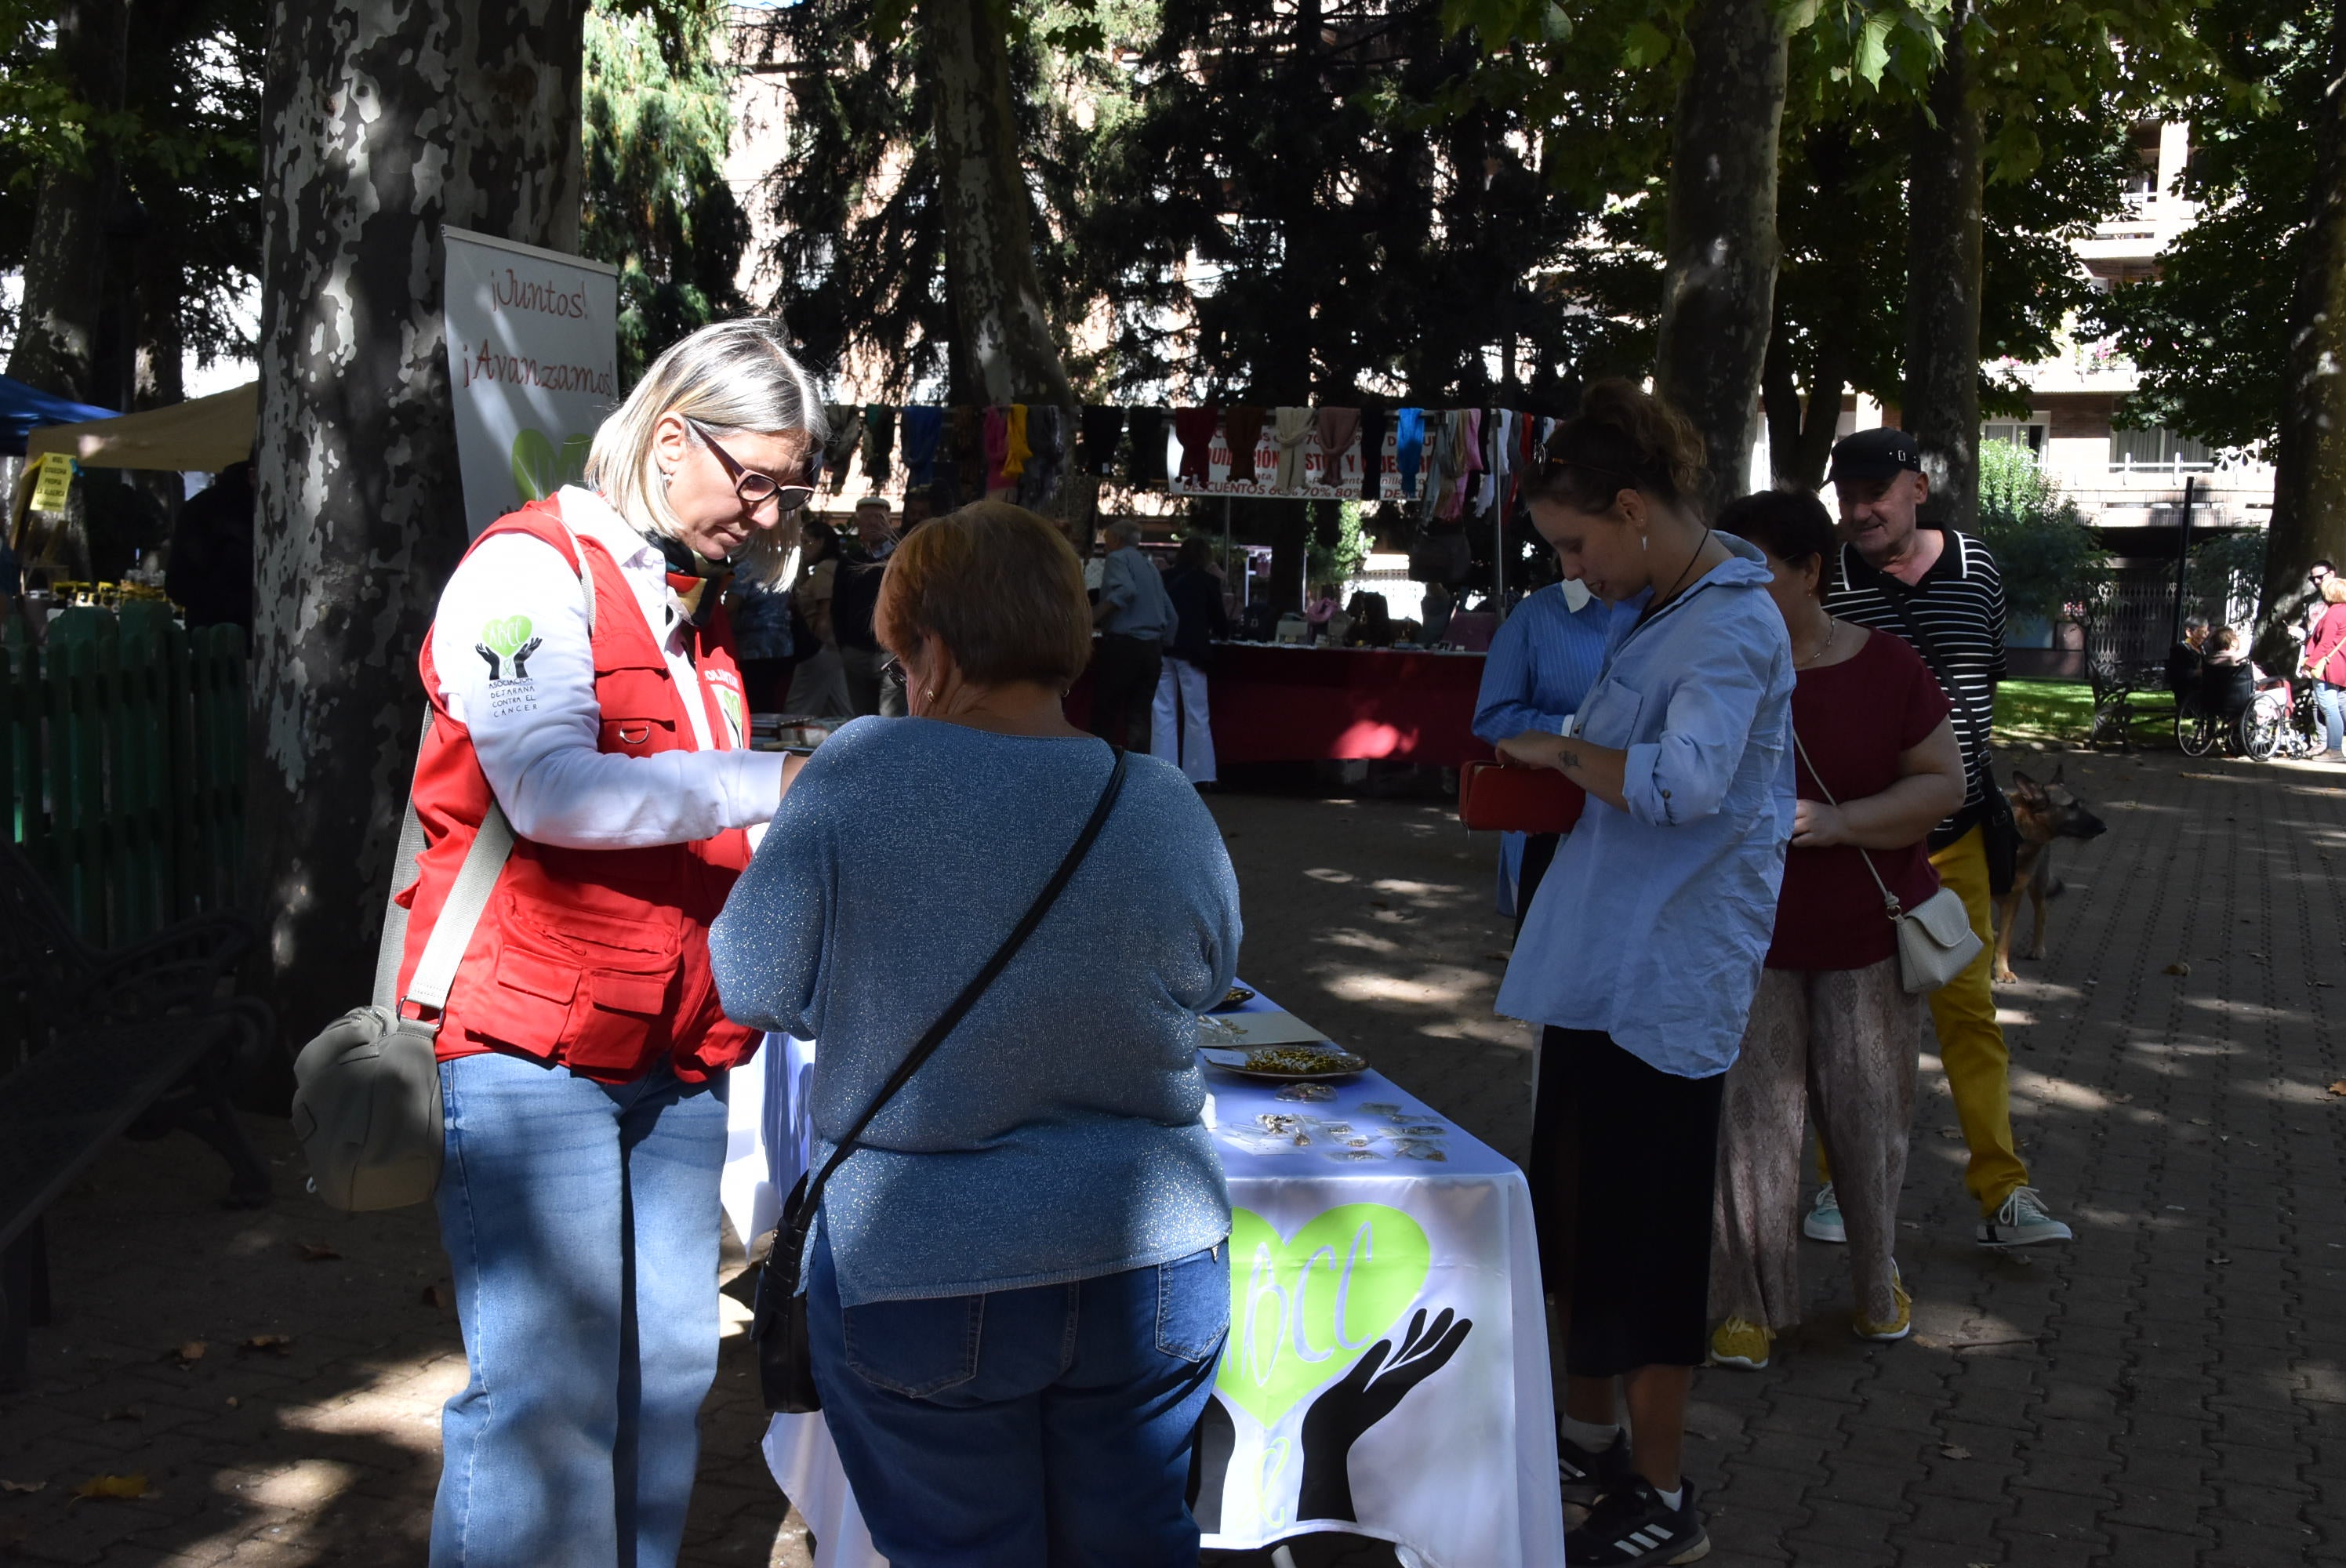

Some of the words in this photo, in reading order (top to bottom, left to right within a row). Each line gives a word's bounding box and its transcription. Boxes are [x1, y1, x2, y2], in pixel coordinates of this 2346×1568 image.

[491, 268, 587, 320] ¡Juntos!
[463, 338, 616, 397] ¡Avanzamos!
[1302, 487, 1331, 497] 70%
[492, 696, 521, 708] CONTRA
[493, 703, 538, 717] CANCER
[1225, 1221, 1372, 1387] BCC
